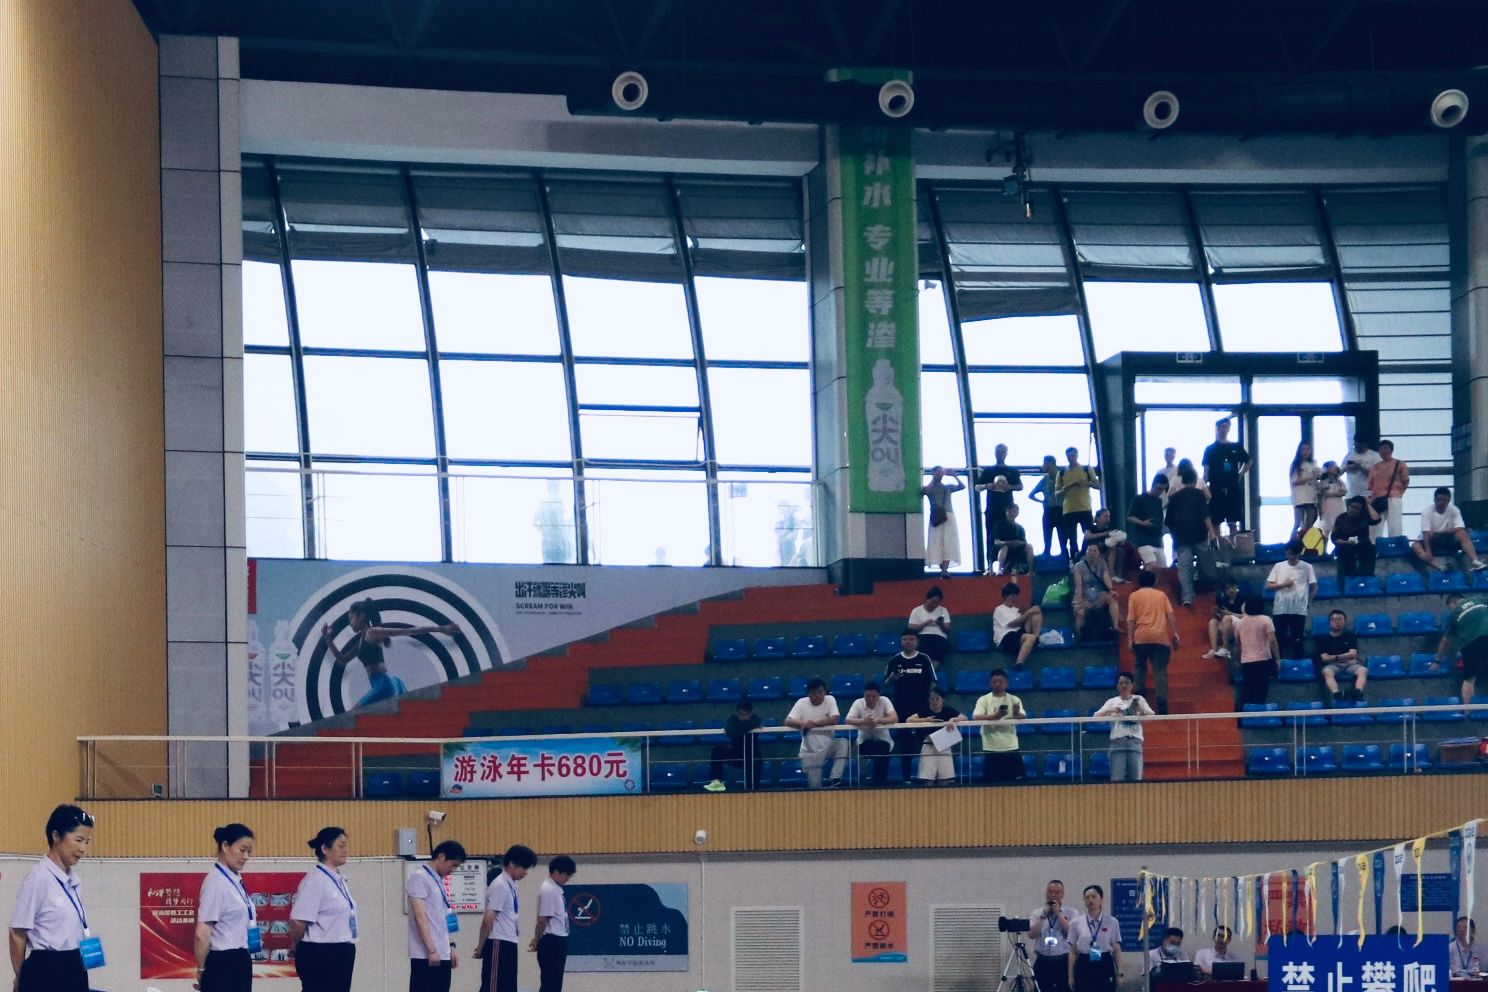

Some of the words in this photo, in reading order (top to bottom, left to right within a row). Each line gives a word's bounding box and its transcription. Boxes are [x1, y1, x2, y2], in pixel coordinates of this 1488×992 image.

[453, 751, 628, 783] 游泳年卡680元
[619, 923, 672, 935] 禁止跳水
[619, 936, 634, 946] NO
[637, 936, 667, 948] Diving
